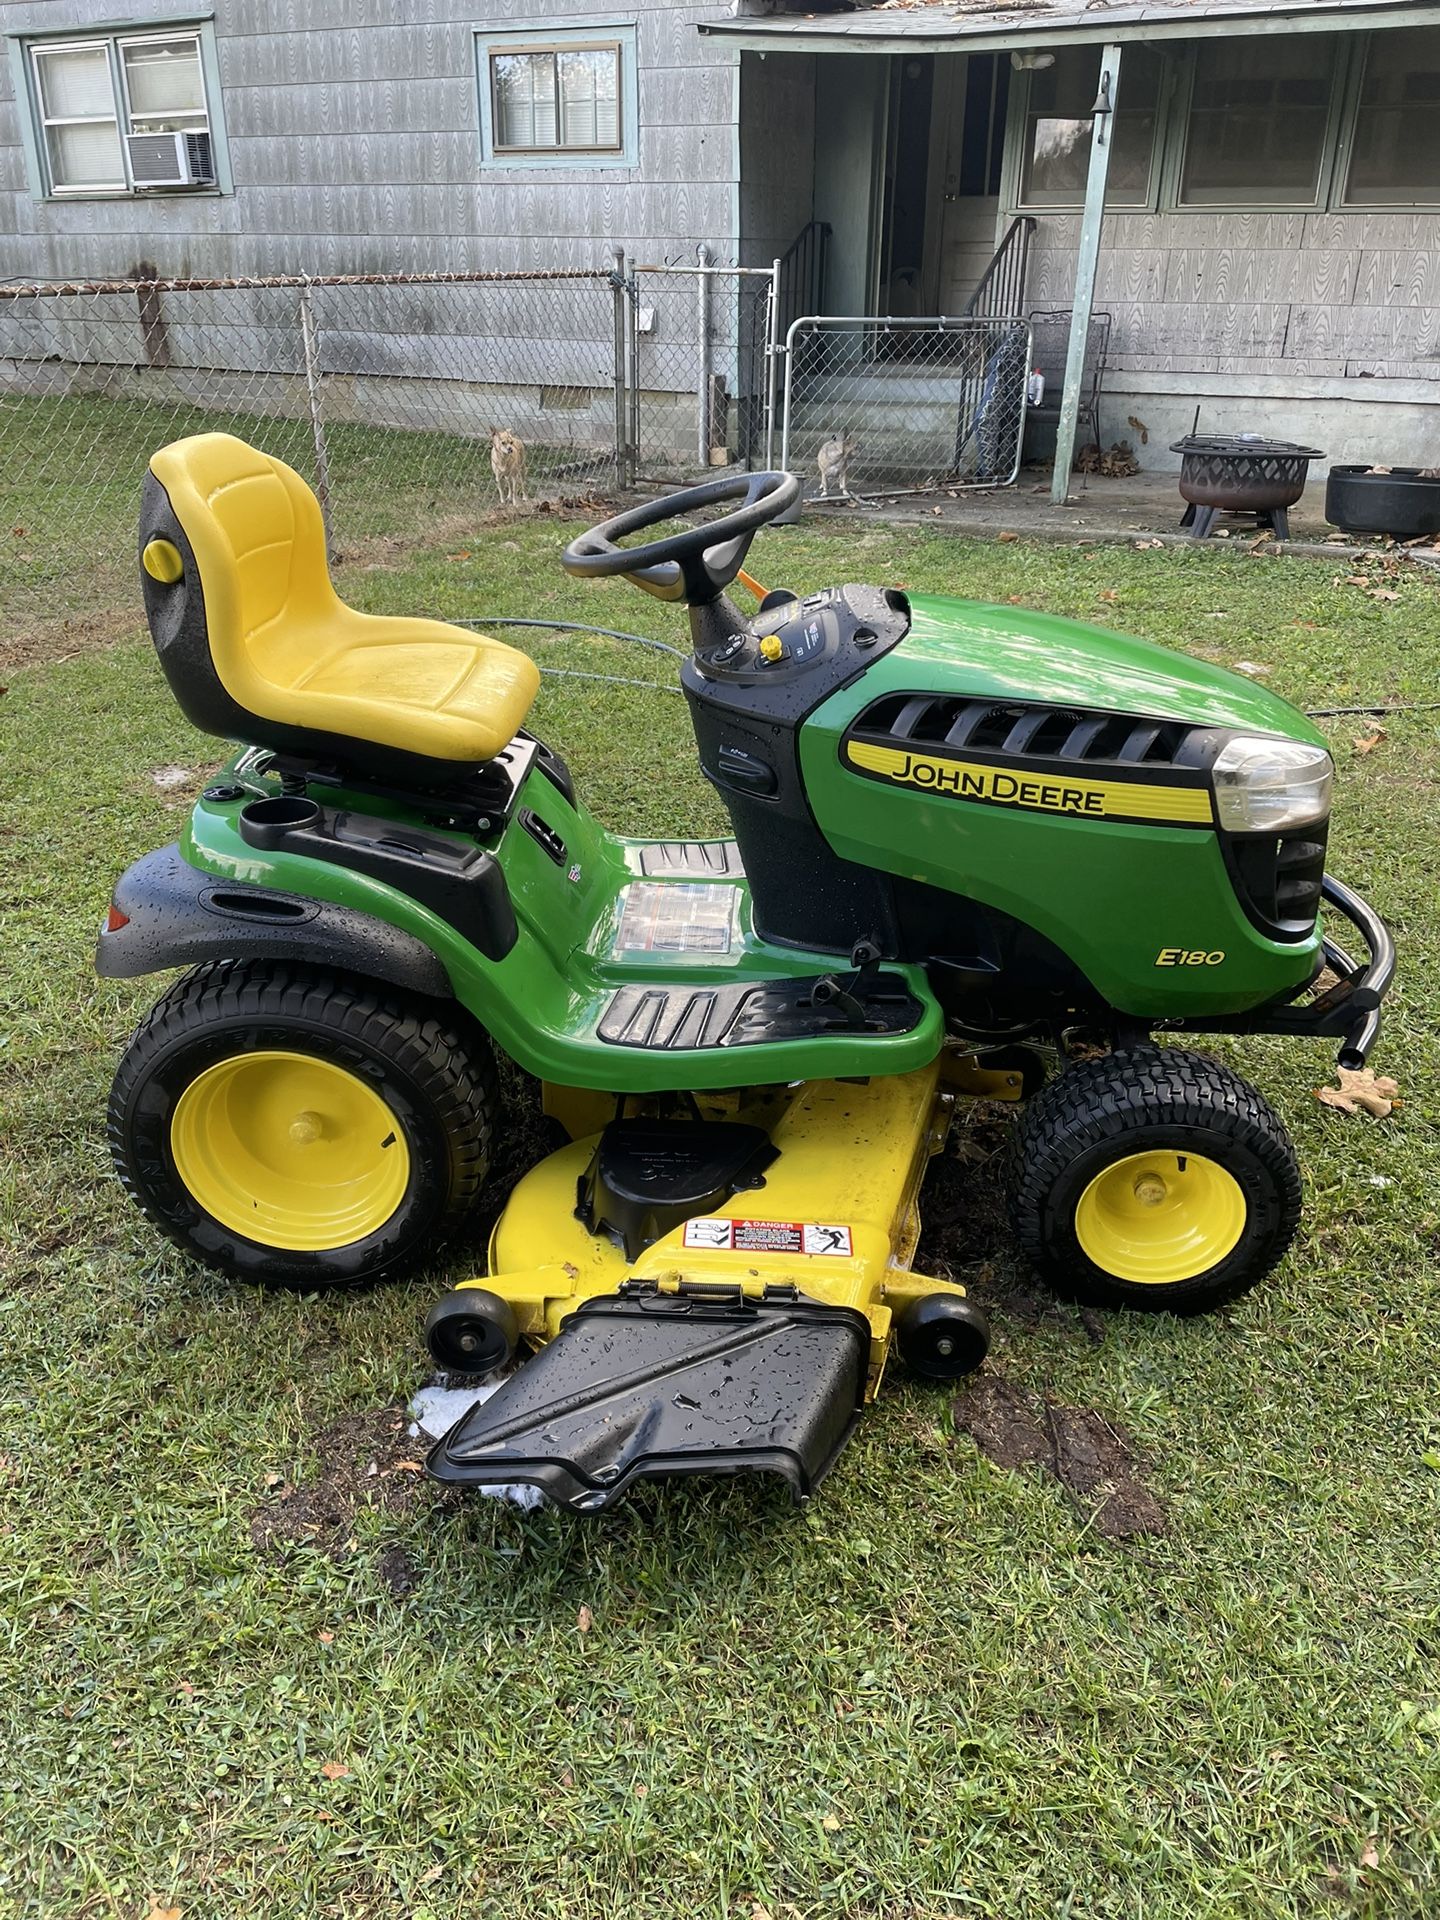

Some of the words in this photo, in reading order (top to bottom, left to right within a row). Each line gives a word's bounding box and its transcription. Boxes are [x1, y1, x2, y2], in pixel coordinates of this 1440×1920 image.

[892, 755, 985, 795] JOHN
[992, 773, 1105, 812] DEERE
[1155, 948, 1226, 966] E180
[753, 1221, 794, 1229] DANGER
